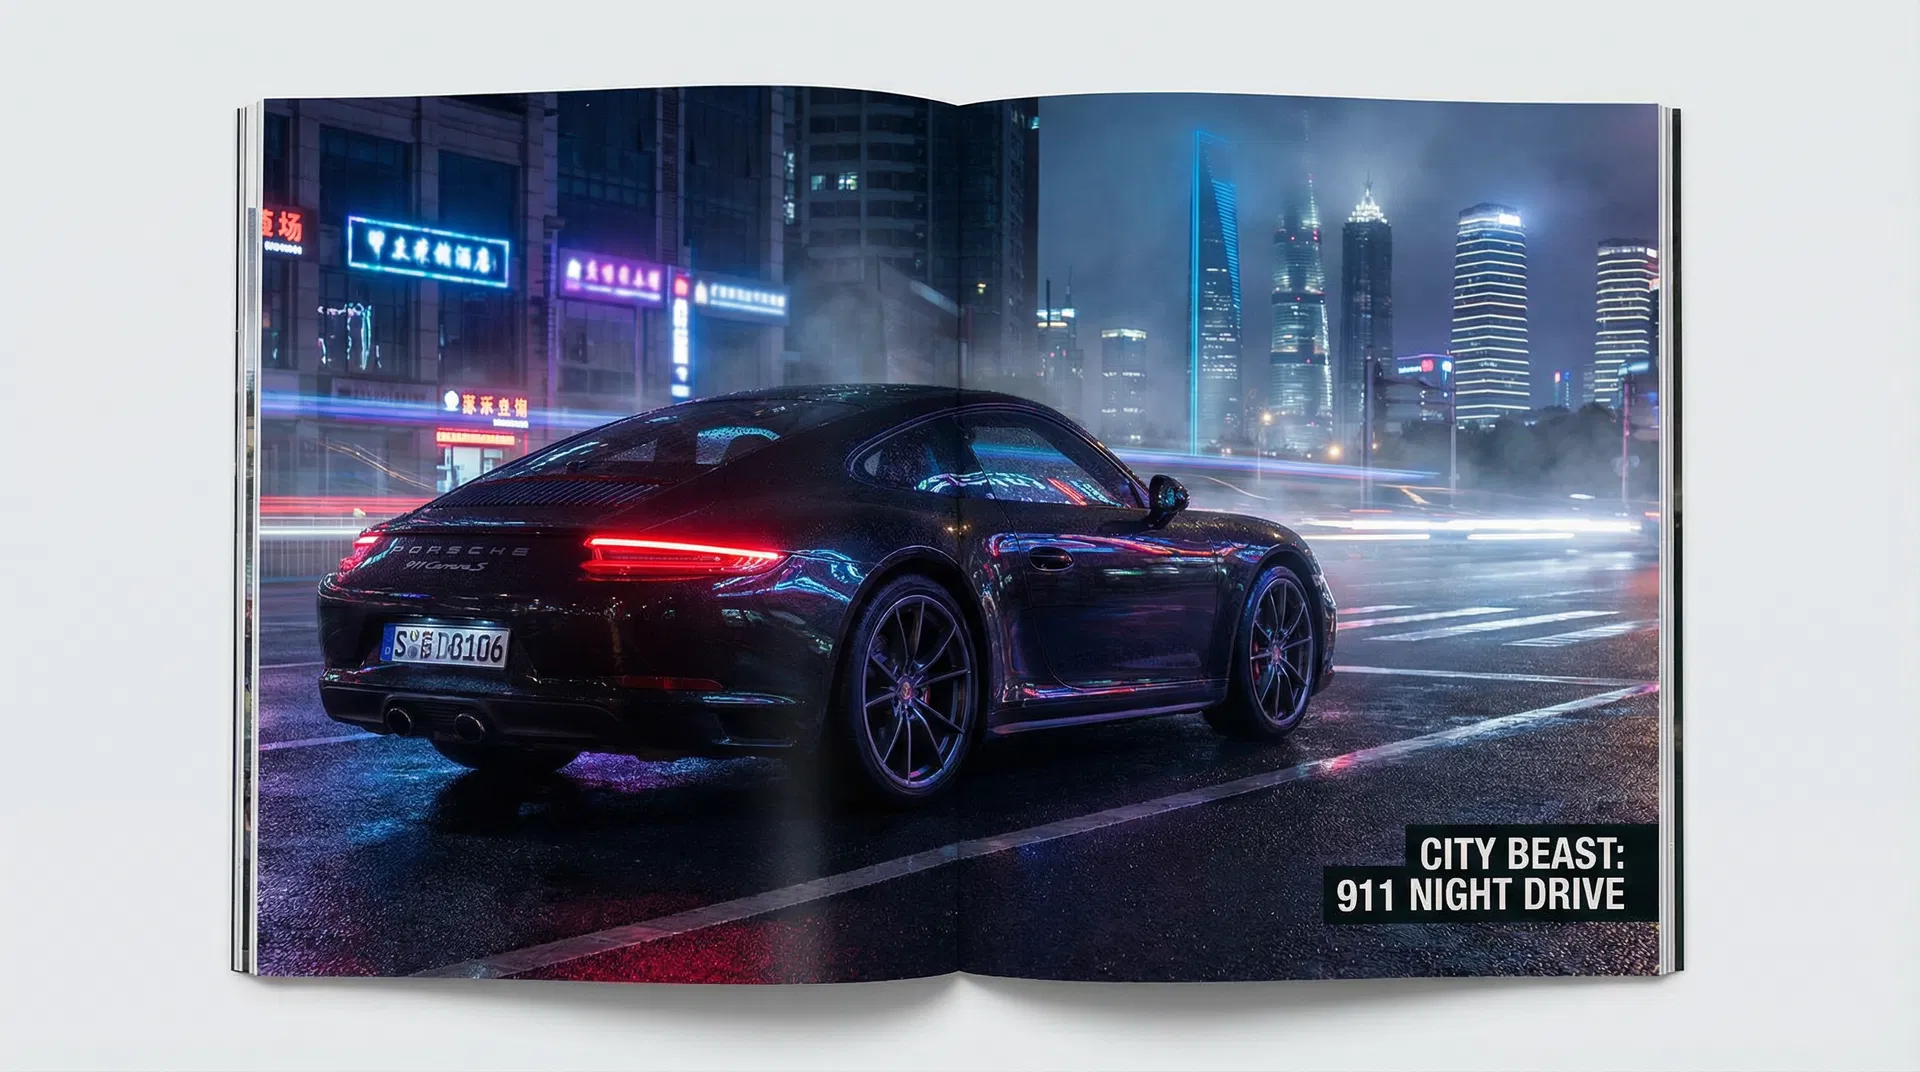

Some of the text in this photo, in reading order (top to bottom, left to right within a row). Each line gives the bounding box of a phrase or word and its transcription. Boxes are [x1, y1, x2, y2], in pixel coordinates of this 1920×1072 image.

[390, 545, 530, 557] PORSCHE
[402, 560, 425, 570] 911
[468, 561, 489, 572] S
[1420, 836, 1624, 871] CITY BEAST:
[1336, 876, 1625, 912] 911 NIGHT DRIVE
